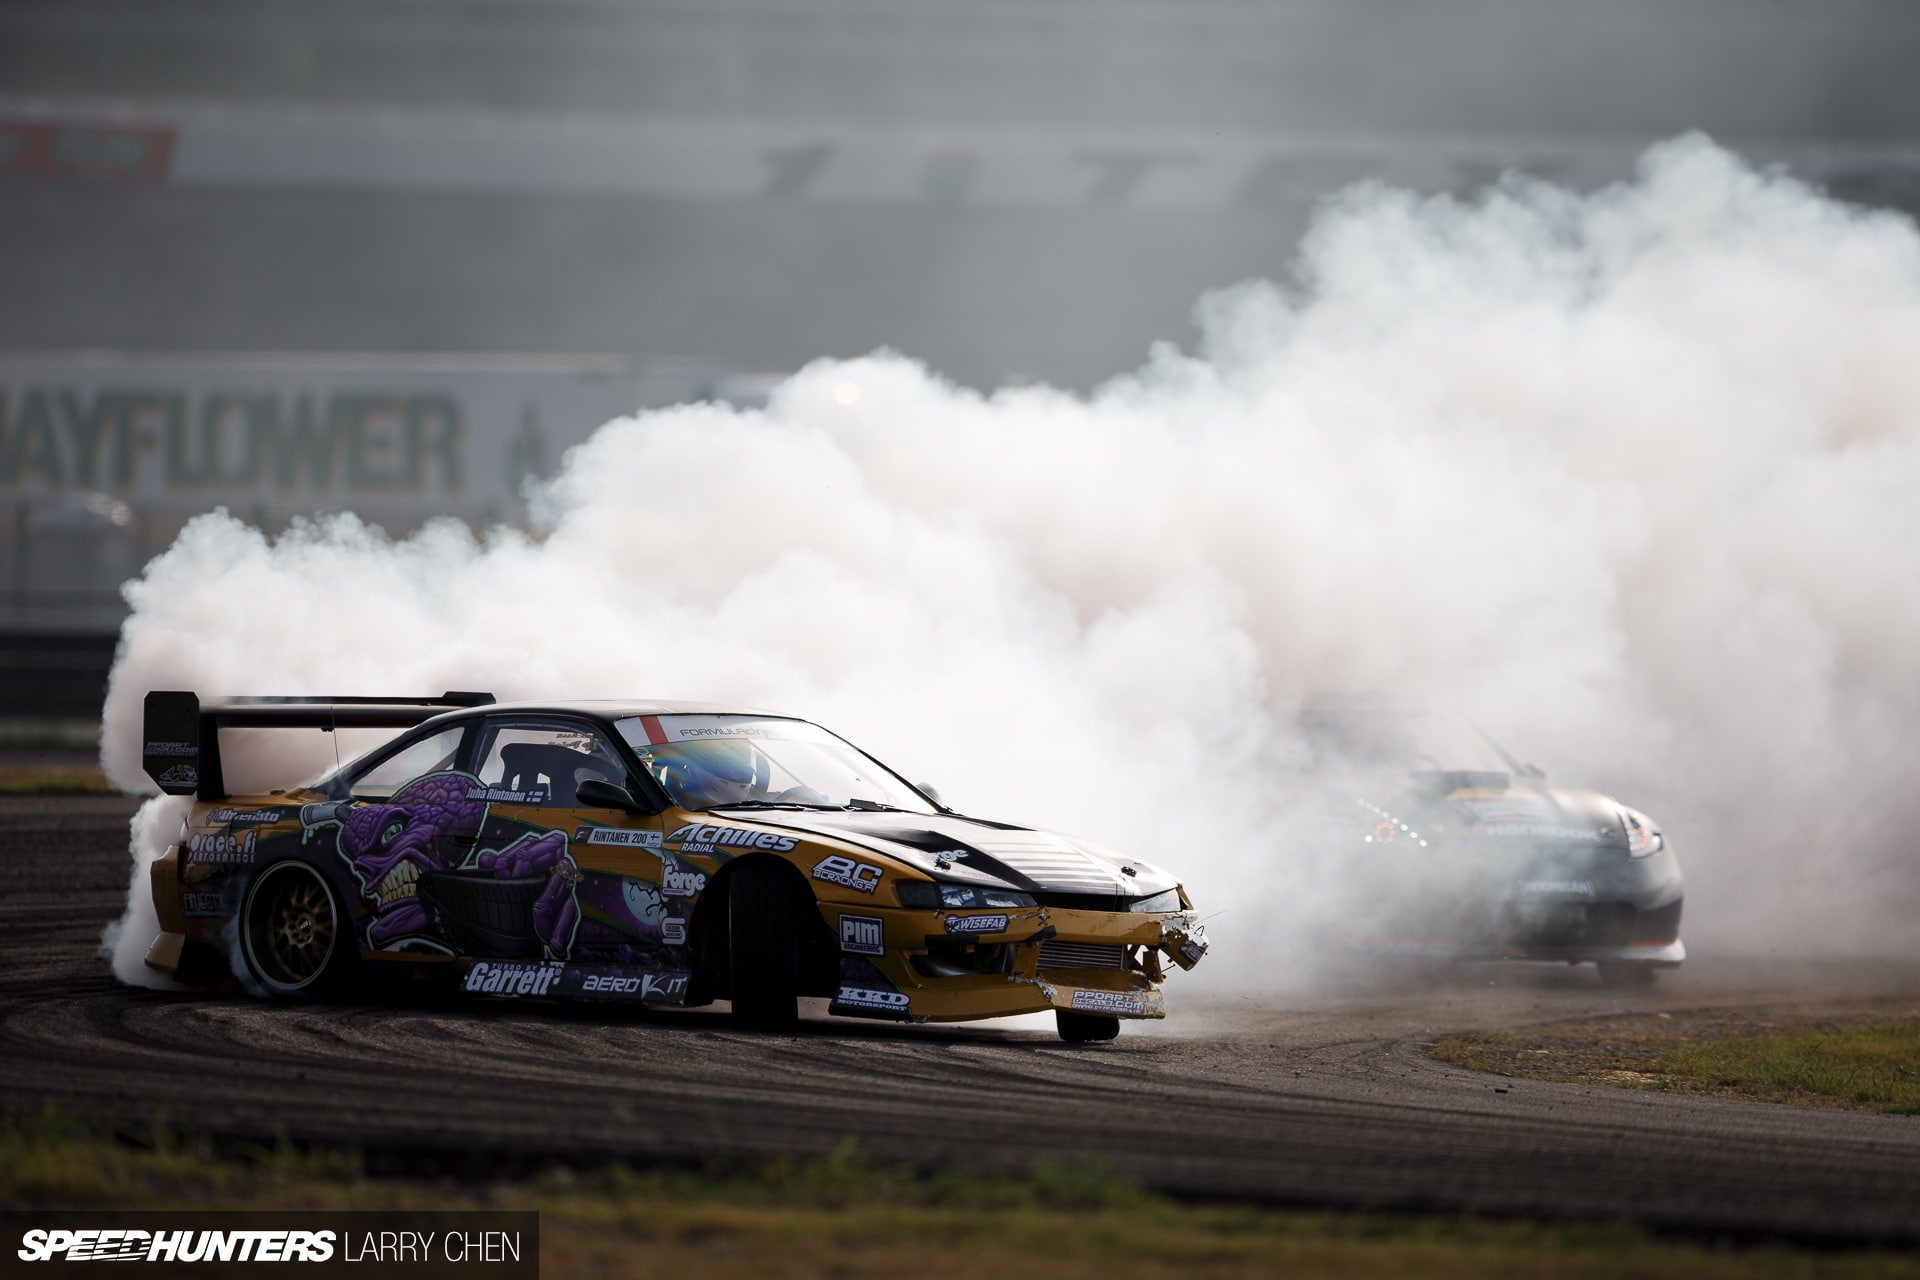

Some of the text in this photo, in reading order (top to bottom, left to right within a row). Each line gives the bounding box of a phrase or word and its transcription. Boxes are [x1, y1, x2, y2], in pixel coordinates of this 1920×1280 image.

[0, 389, 463, 488] AYFLOWER
[466, 786, 526, 802] Juha Rintanen
[593, 830, 631, 843] RINTANEN
[631, 832, 648, 844] 200
[665, 823, 800, 852] Achilles
[681, 843, 714, 853] RADIAL
[188, 853, 255, 864] PERFORMANCE
[813, 854, 884, 886] BC
[663, 865, 706, 897] Forge
[960, 918, 1007, 929] WISEFAB
[491, 963, 538, 972] TURBO BY
[465, 962, 556, 996] Garrett
[838, 986, 911, 1006] KKD
[1074, 990, 1134, 1001] PPDART
[837, 998, 908, 1012] MOTORSPORT
